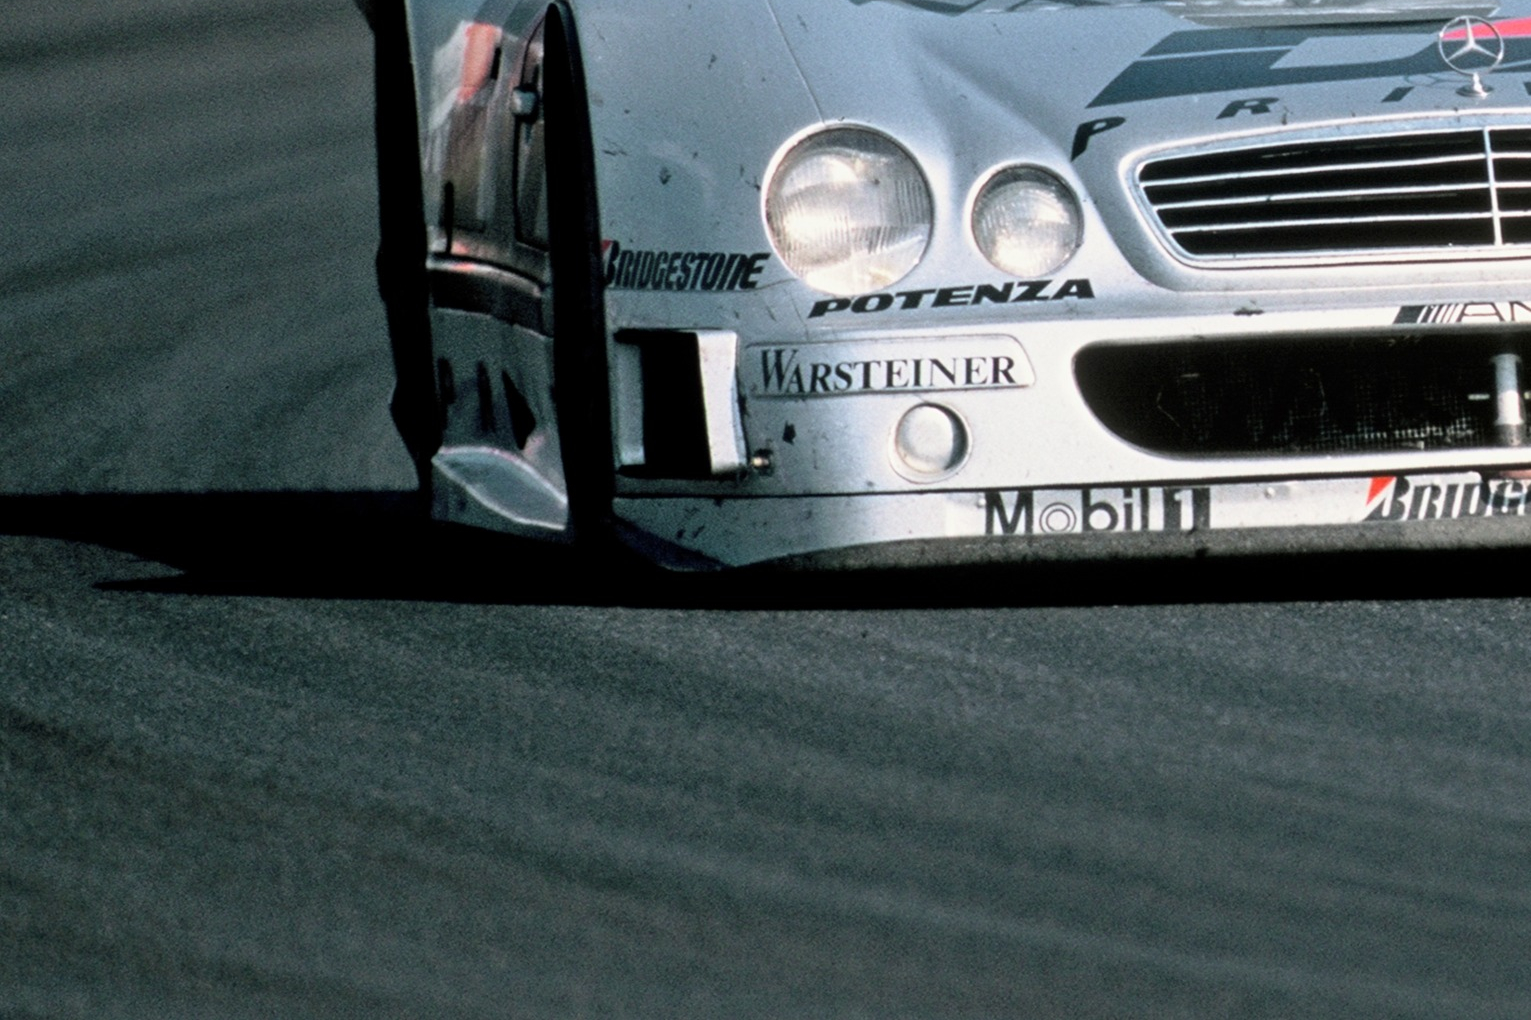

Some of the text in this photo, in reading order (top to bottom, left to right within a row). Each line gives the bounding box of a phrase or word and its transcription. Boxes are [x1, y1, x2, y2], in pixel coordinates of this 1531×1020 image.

[603, 240, 771, 291] BRIDGESTONE
[807, 279, 1095, 318] POTENZA
[760, 348, 1018, 393] WARSTEINER
[985, 487, 1149, 535] Mobil
